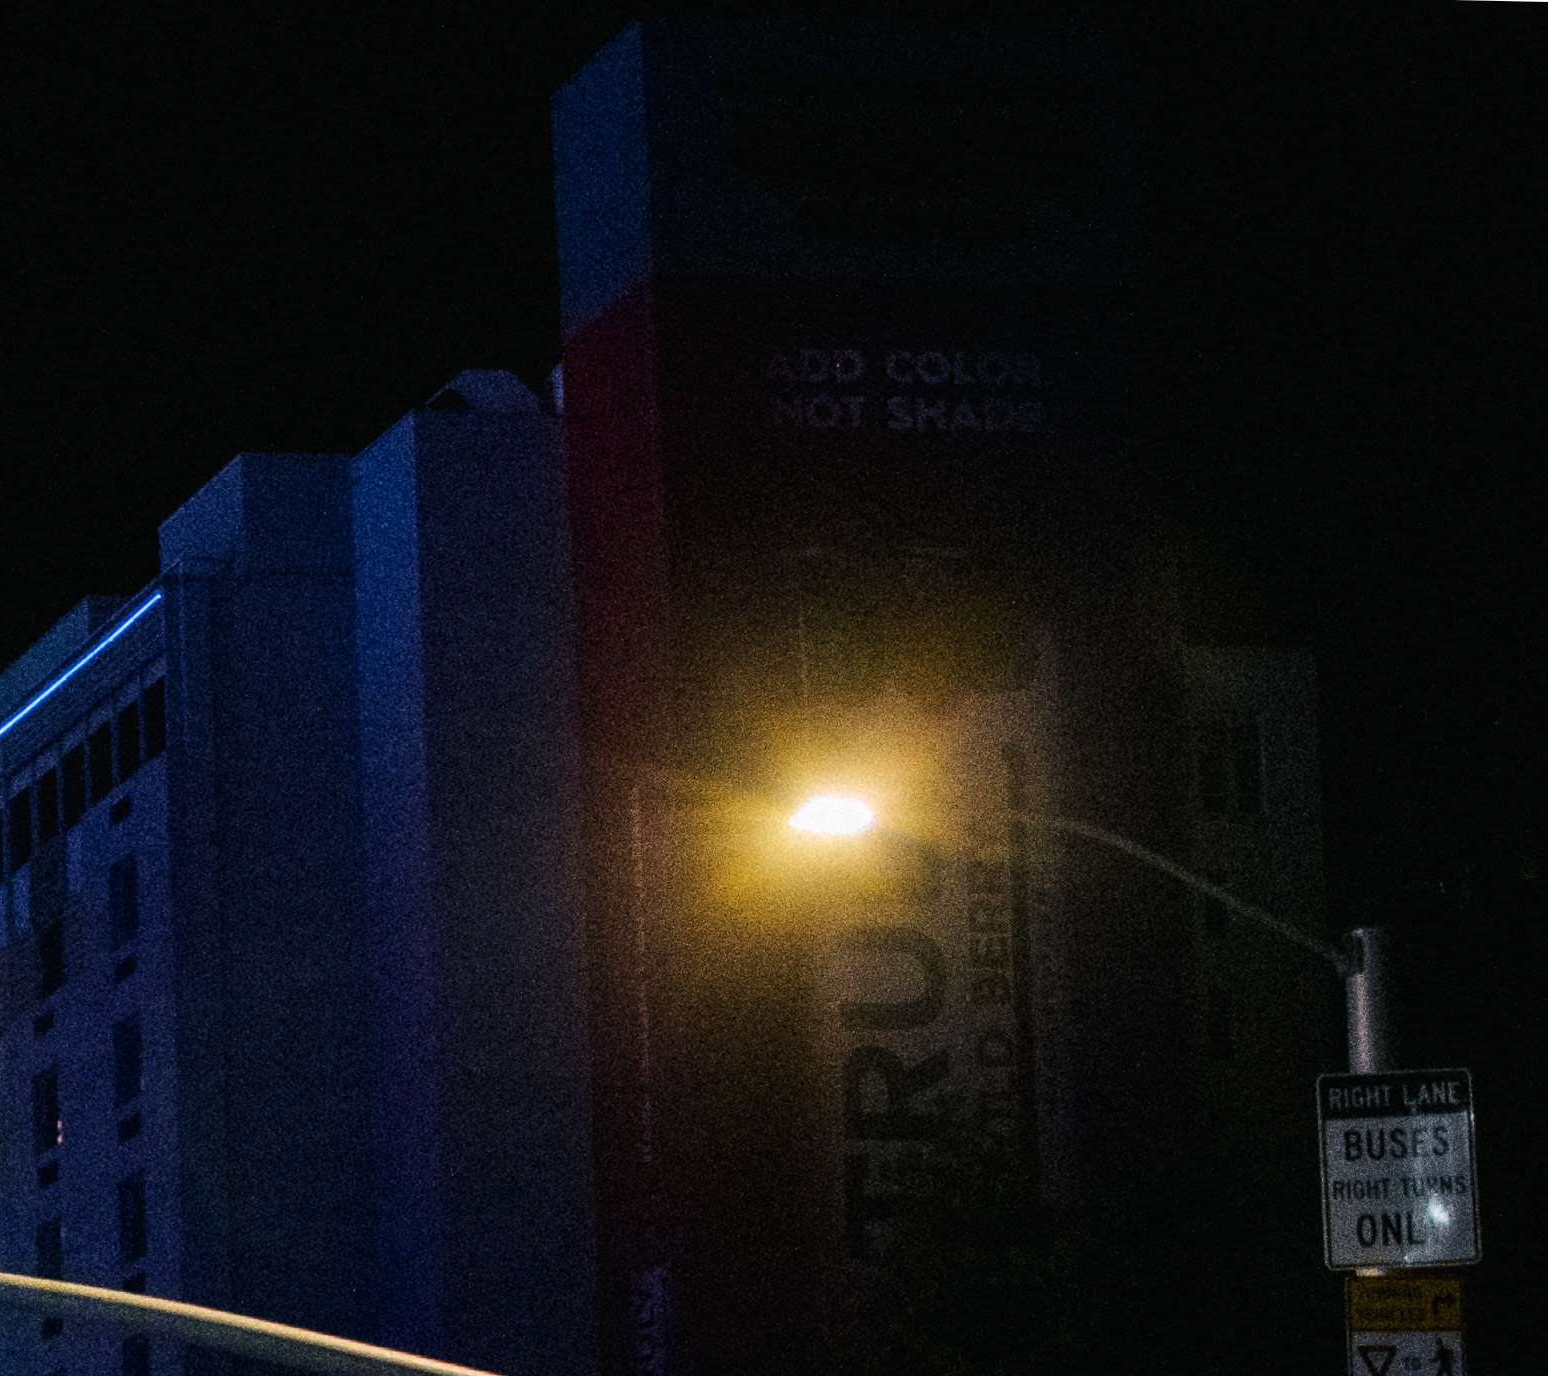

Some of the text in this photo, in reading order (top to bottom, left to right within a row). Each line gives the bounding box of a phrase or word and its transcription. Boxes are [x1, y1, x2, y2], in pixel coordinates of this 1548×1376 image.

[1328, 1080, 1461, 1110] RIGHT LANE
[1344, 1127, 1450, 1162] BUSES
[1333, 1179, 1389, 1201] RIGHT
[1357, 1212, 1431, 1248] ONL
